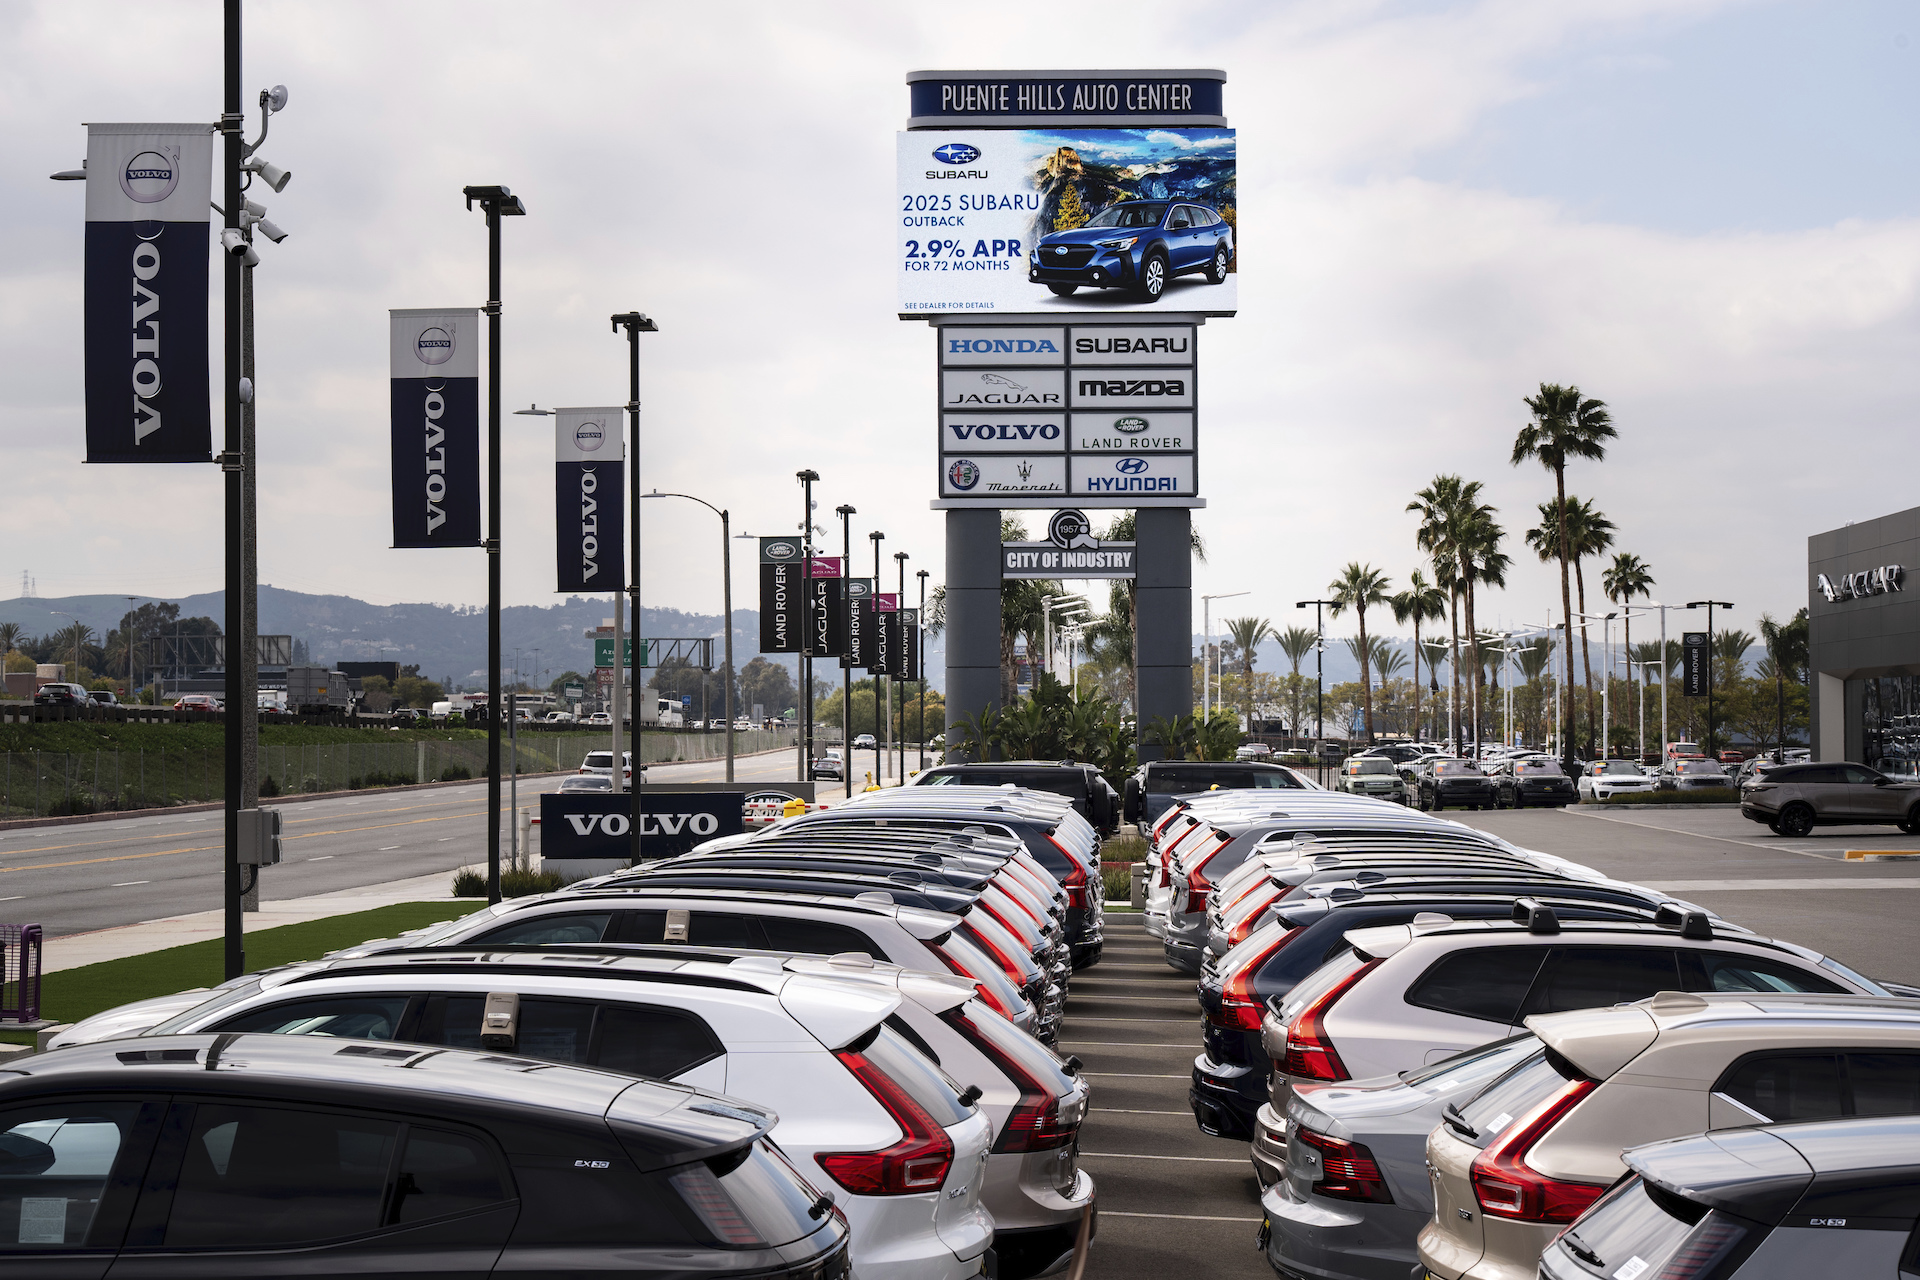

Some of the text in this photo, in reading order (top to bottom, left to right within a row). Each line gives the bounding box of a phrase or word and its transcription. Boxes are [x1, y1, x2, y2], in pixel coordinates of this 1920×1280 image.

[942, 83, 1192, 111] PUENTE HILLS AUTO CENTER
[128, 169, 171, 179] VOLVO
[925, 170, 989, 180] SUBARU
[902, 193, 1040, 211] 2025 SUBARU
[903, 216, 965, 227] OUTBACK
[905, 239, 1022, 258] 2.9% APR
[905, 260, 1010, 271] FOR 72 MONTHS
[965, 301, 995, 309] DETAILS
[132, 242, 161, 446] VOLVO
[949, 339, 1059, 353] HONDA
[1075, 338, 1187, 353] SUBARU
[948, 393, 1060, 404] JAGUAR
[949, 424, 1060, 440] VOLVO
[1082, 437, 1182, 448] LAND ROVER
[425, 392, 446, 535] VOLVO
[986, 483, 1063, 491] Maserati
[1088, 477, 1177, 491] HYUNDAI
[581, 472, 598, 583] VOLVO
[1059, 525, 1078, 535] 1957
[1006, 551, 1132, 568] CITY OF INDUSTRY
[776, 565, 786, 648] LAND ROVER
[818, 582, 828, 653] JAGUAR
[851, 600, 860, 665] LAND ROVER
[879, 615, 887, 671] JAGUAR
[564, 813, 718, 836] VOLVO
